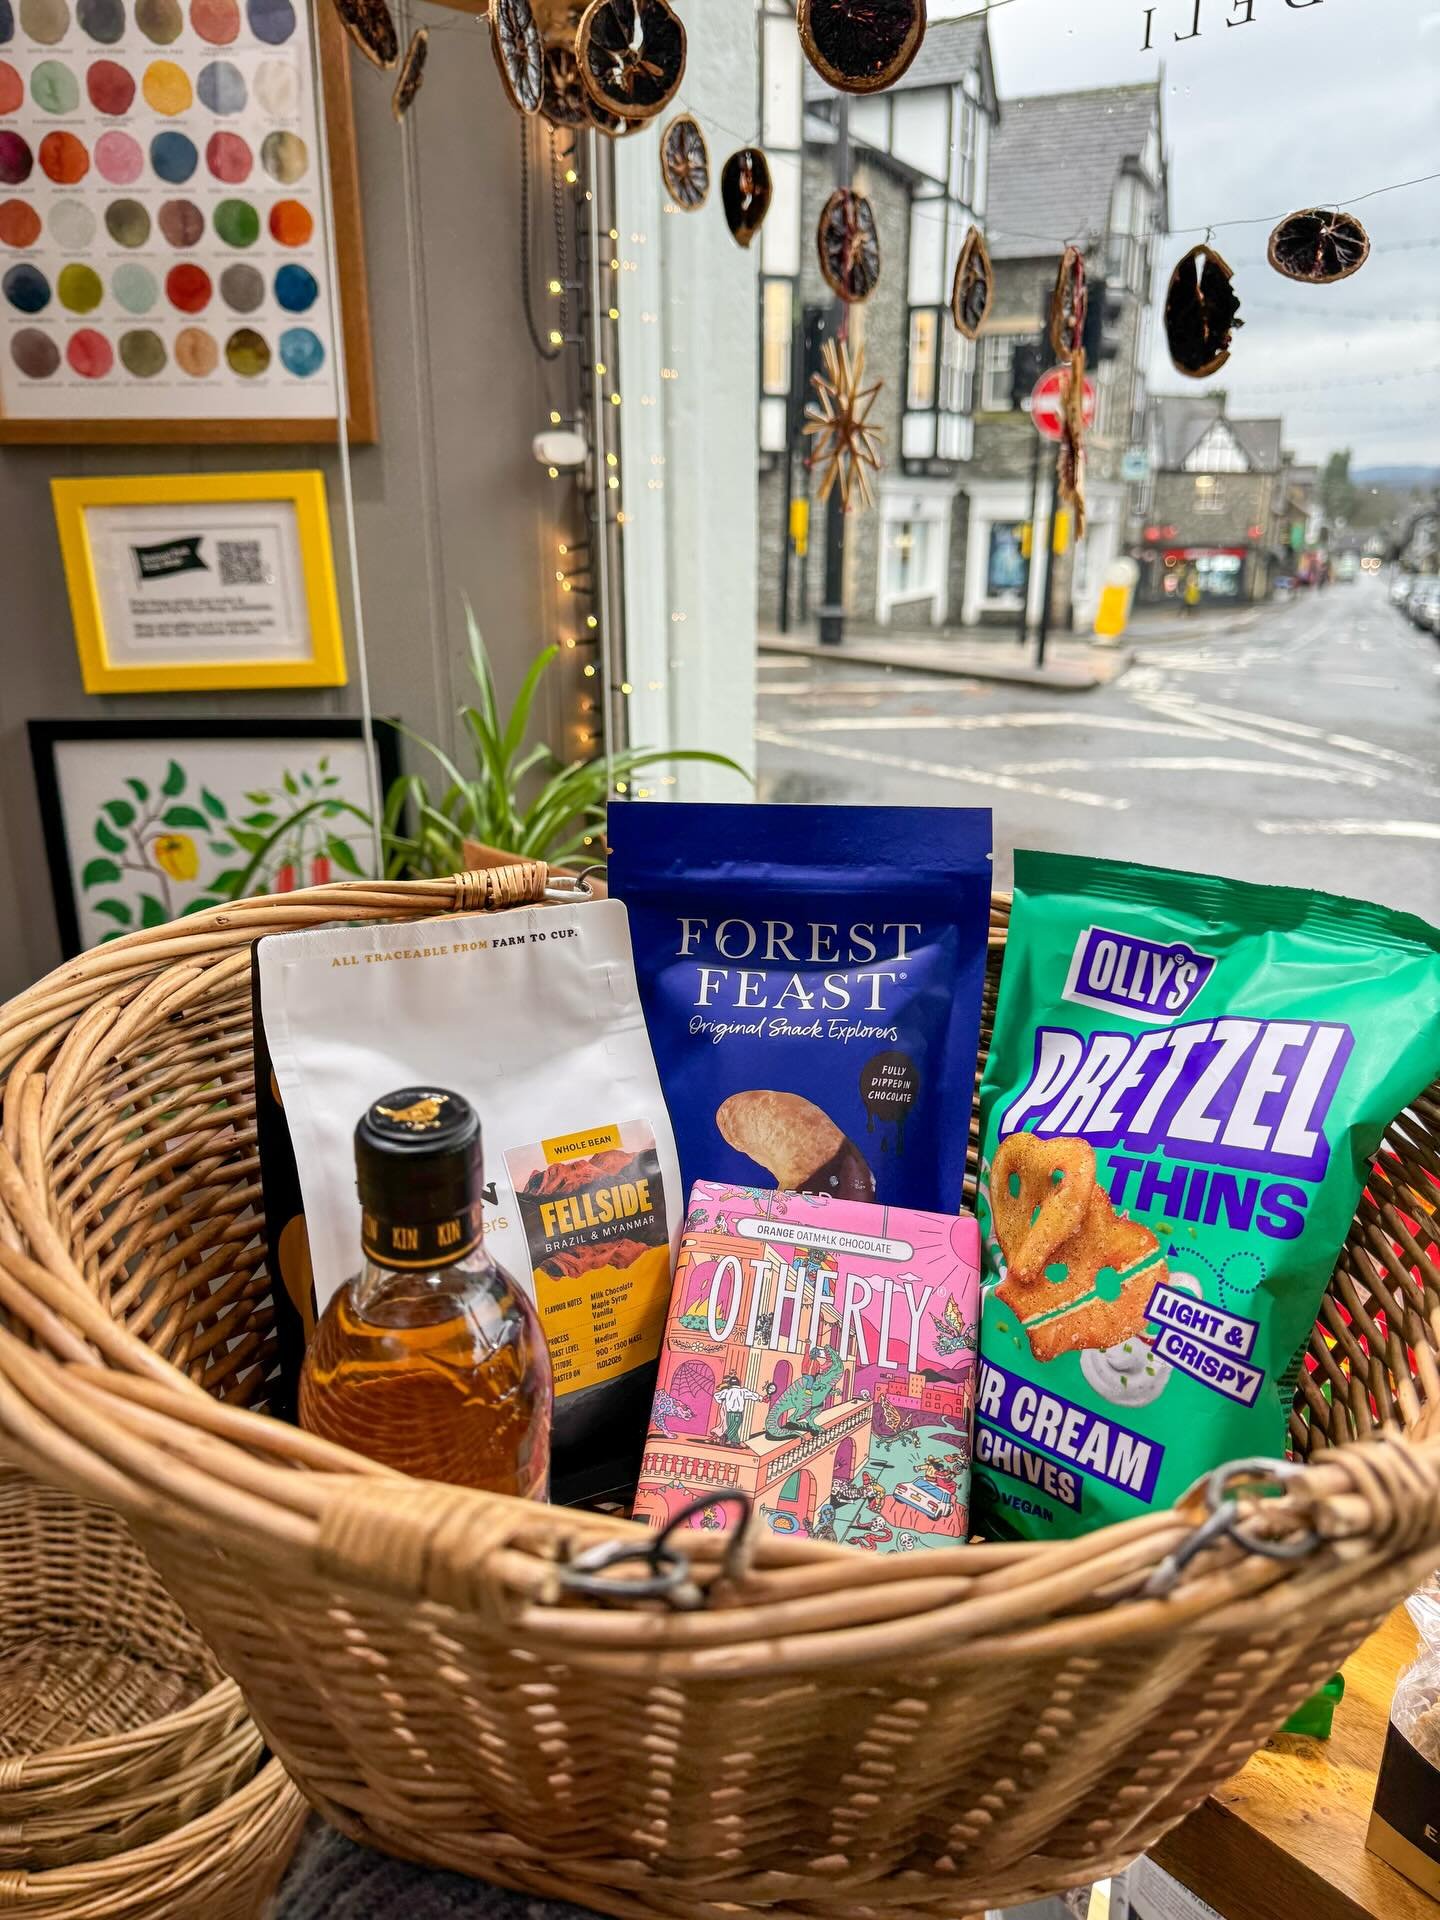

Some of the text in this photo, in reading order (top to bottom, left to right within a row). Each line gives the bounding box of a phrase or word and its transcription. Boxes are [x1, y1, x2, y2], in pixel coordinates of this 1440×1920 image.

[331, 929, 578, 968] ALL TRACEABLE FROM FARM TO CUP.
[675, 917, 922, 963] FOREST
[1088, 940, 1198, 1010] OLLY'S
[688, 1014, 898, 1045] Original Snack Explorers
[871, 1077, 912, 1090] DIPPED IN
[881, 1065, 907, 1076] FULLY
[868, 1090, 912, 1103] CHOCOLATE
[1005, 1022, 1343, 1158] PRETZEL
[553, 1135, 612, 1155] WHOLE BEAN
[540, 1179, 652, 1237] FELLSIDE
[1107, 1156, 1308, 1240] THINS
[393, 1228, 417, 1249] KIN
[438, 1219, 461, 1246] KIN
[545, 1216, 654, 1253] BRAZIL & MYANMAR
[757, 1224, 794, 1239] ORANGE
[838, 1236, 892, 1254] CHOCOLATE
[545, 1298, 582, 1314] FLAVOUR NOTES
[591, 1282, 633, 1301] Milk Chocolate
[592, 1294, 628, 1310] Maple Syrup
[593, 1308, 612, 1319] Vanilla
[594, 1319, 616, 1332] Natural
[708, 1256, 932, 1372] OTHERLY
[1155, 1294, 1245, 1348] LIGHT &
[552, 1344, 579, 1359] OAST LEVEL
[595, 1332, 618, 1345] Medium
[596, 1348, 608, 1357] 900
[614, 1341, 627, 1351] 1300
[554, 1370, 580, 1384] OASTED ON
[1165, 1334, 1255, 1394] CRISPY
[1010, 1386, 1152, 1492] CREAM
[976, 1429, 1077, 1504] CHIVES
[1002, 1492, 1054, 1522] VEGAN
